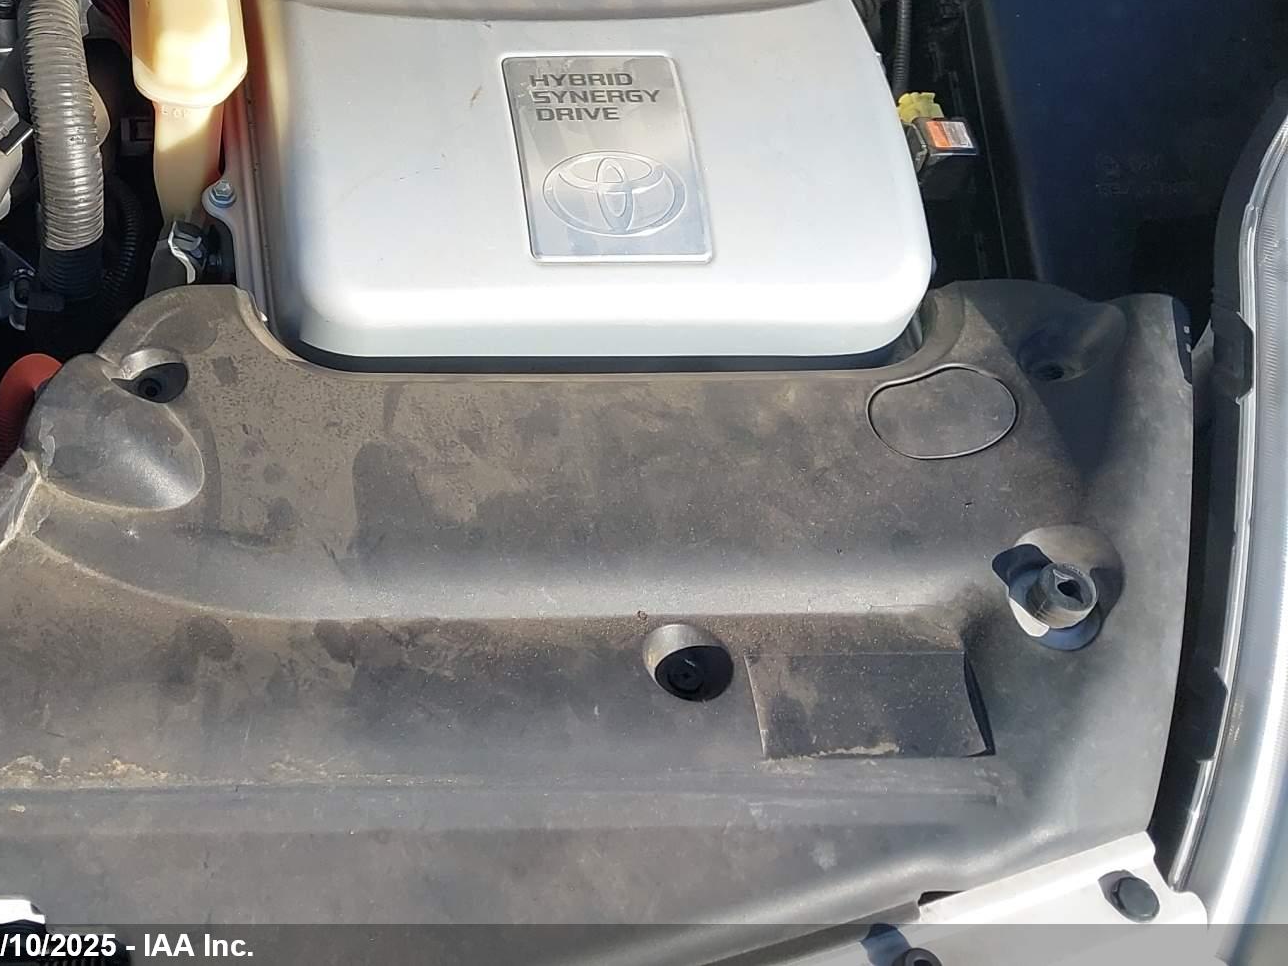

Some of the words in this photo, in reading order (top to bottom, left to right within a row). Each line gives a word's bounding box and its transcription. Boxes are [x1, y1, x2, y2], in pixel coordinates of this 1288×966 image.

[529, 73, 632, 87] HYBRID
[532, 89, 660, 104] SYNERGY
[535, 107, 620, 121] DRIVE
